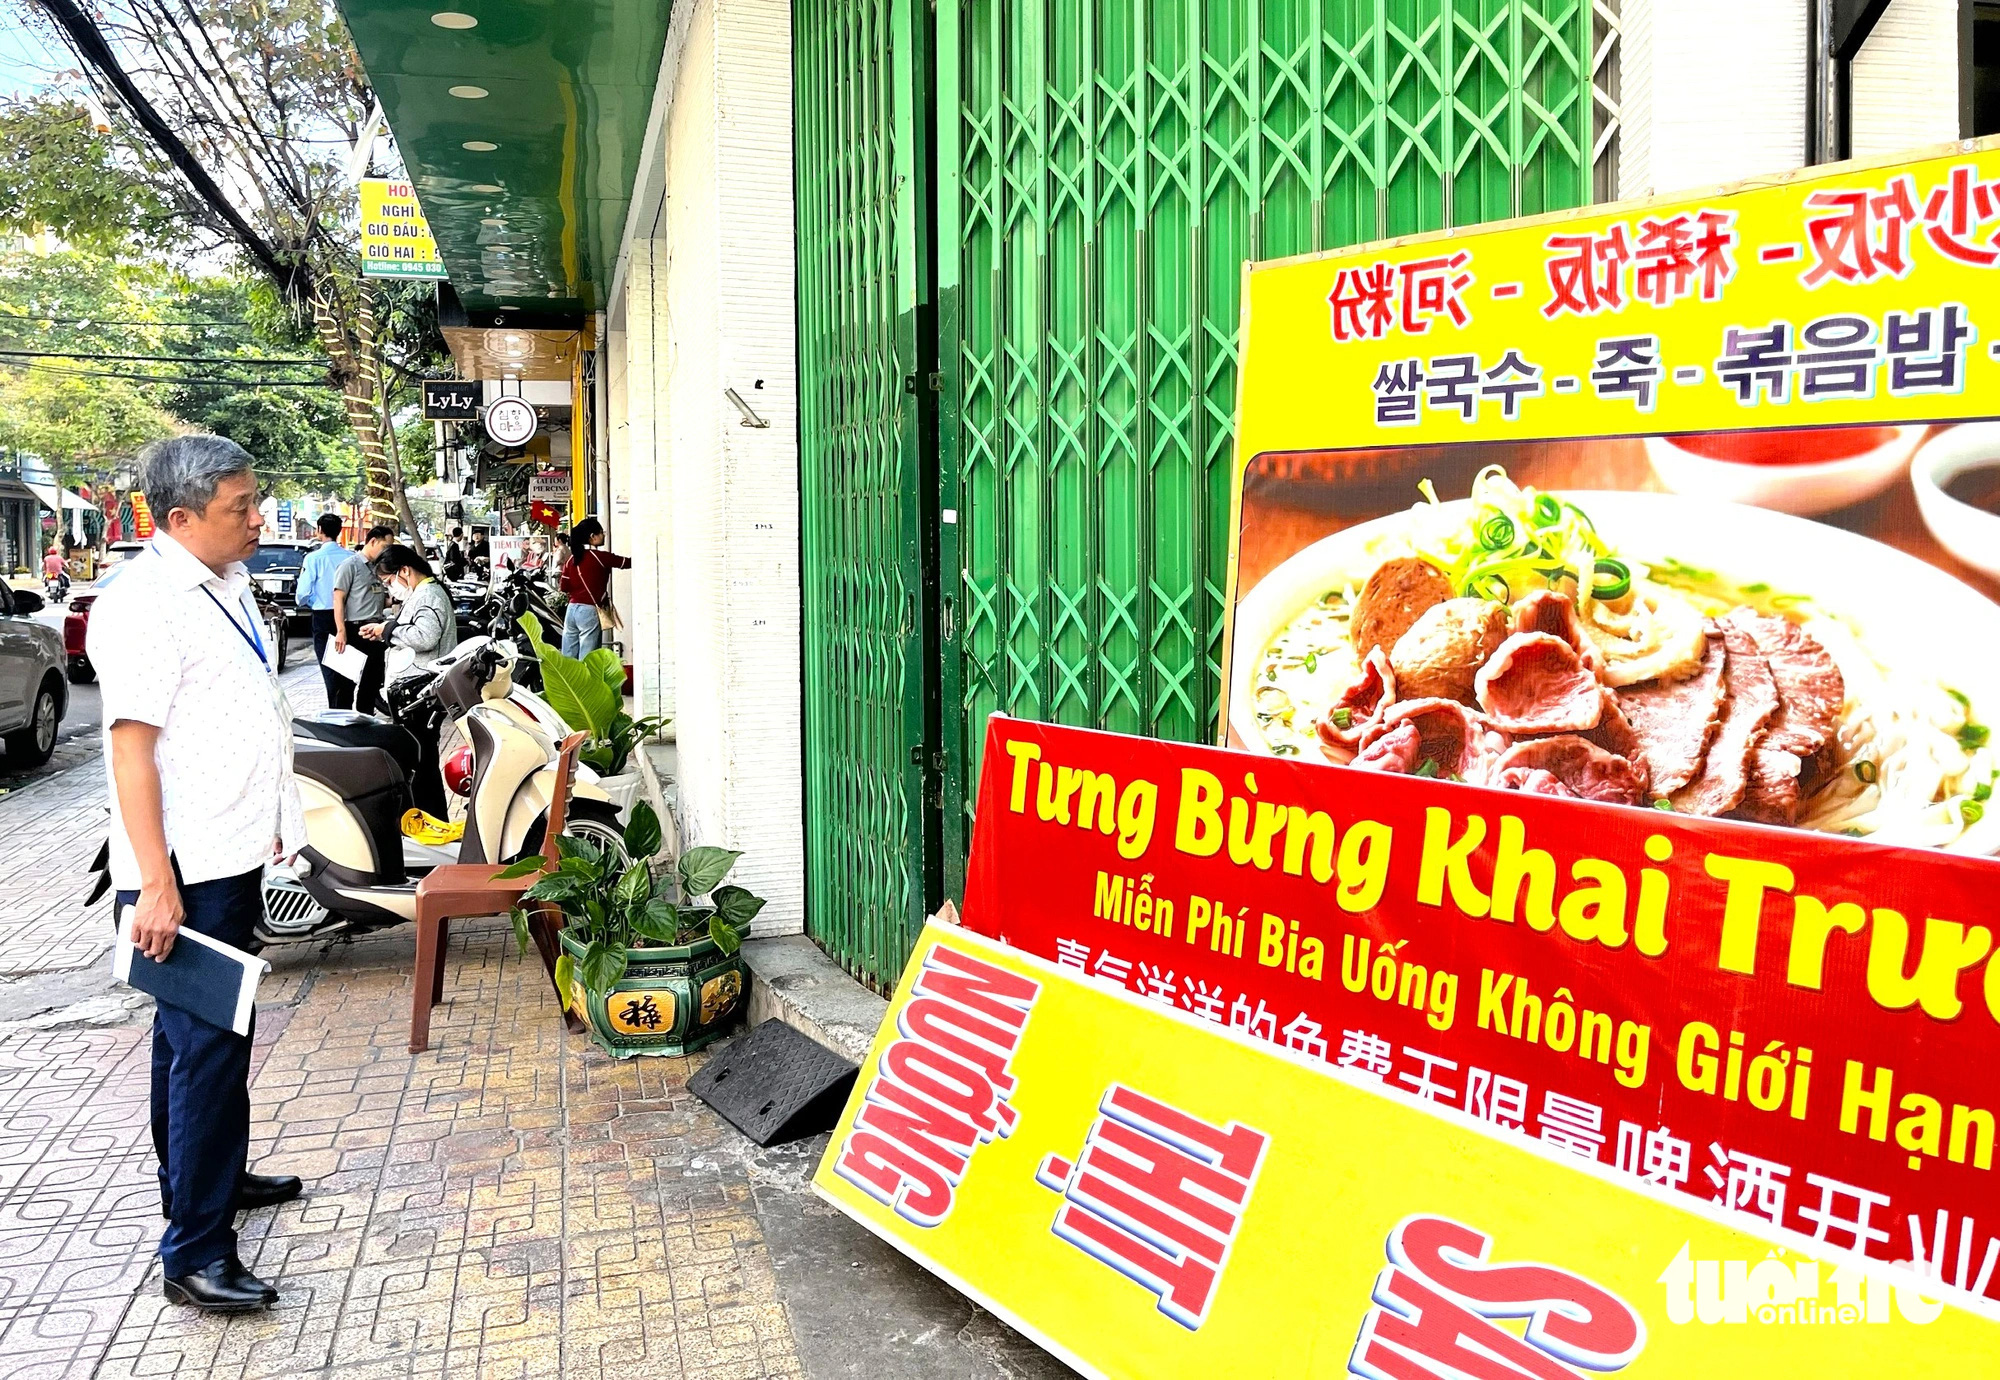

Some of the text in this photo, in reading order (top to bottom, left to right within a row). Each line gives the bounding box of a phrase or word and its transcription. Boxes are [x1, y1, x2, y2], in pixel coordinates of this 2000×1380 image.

[394, 247, 414, 258] HAI
[402, 262, 424, 272] 0945
[427, 392, 474, 410] LyLy
[1373, 352, 1539, 422] 쌀국수
[1592, 338, 1657, 406] 죽
[1717, 306, 1968, 399] 볶음밥
[1007, 739, 2000, 1025] Tưng Bừng Khai Trư
[839, 944, 1040, 1224] NƯỚNG
[1093, 871, 1995, 1171] Miễn Phí Bia Uống Không Giới Hạn
[1043, 1085, 1267, 1322] THỊT
